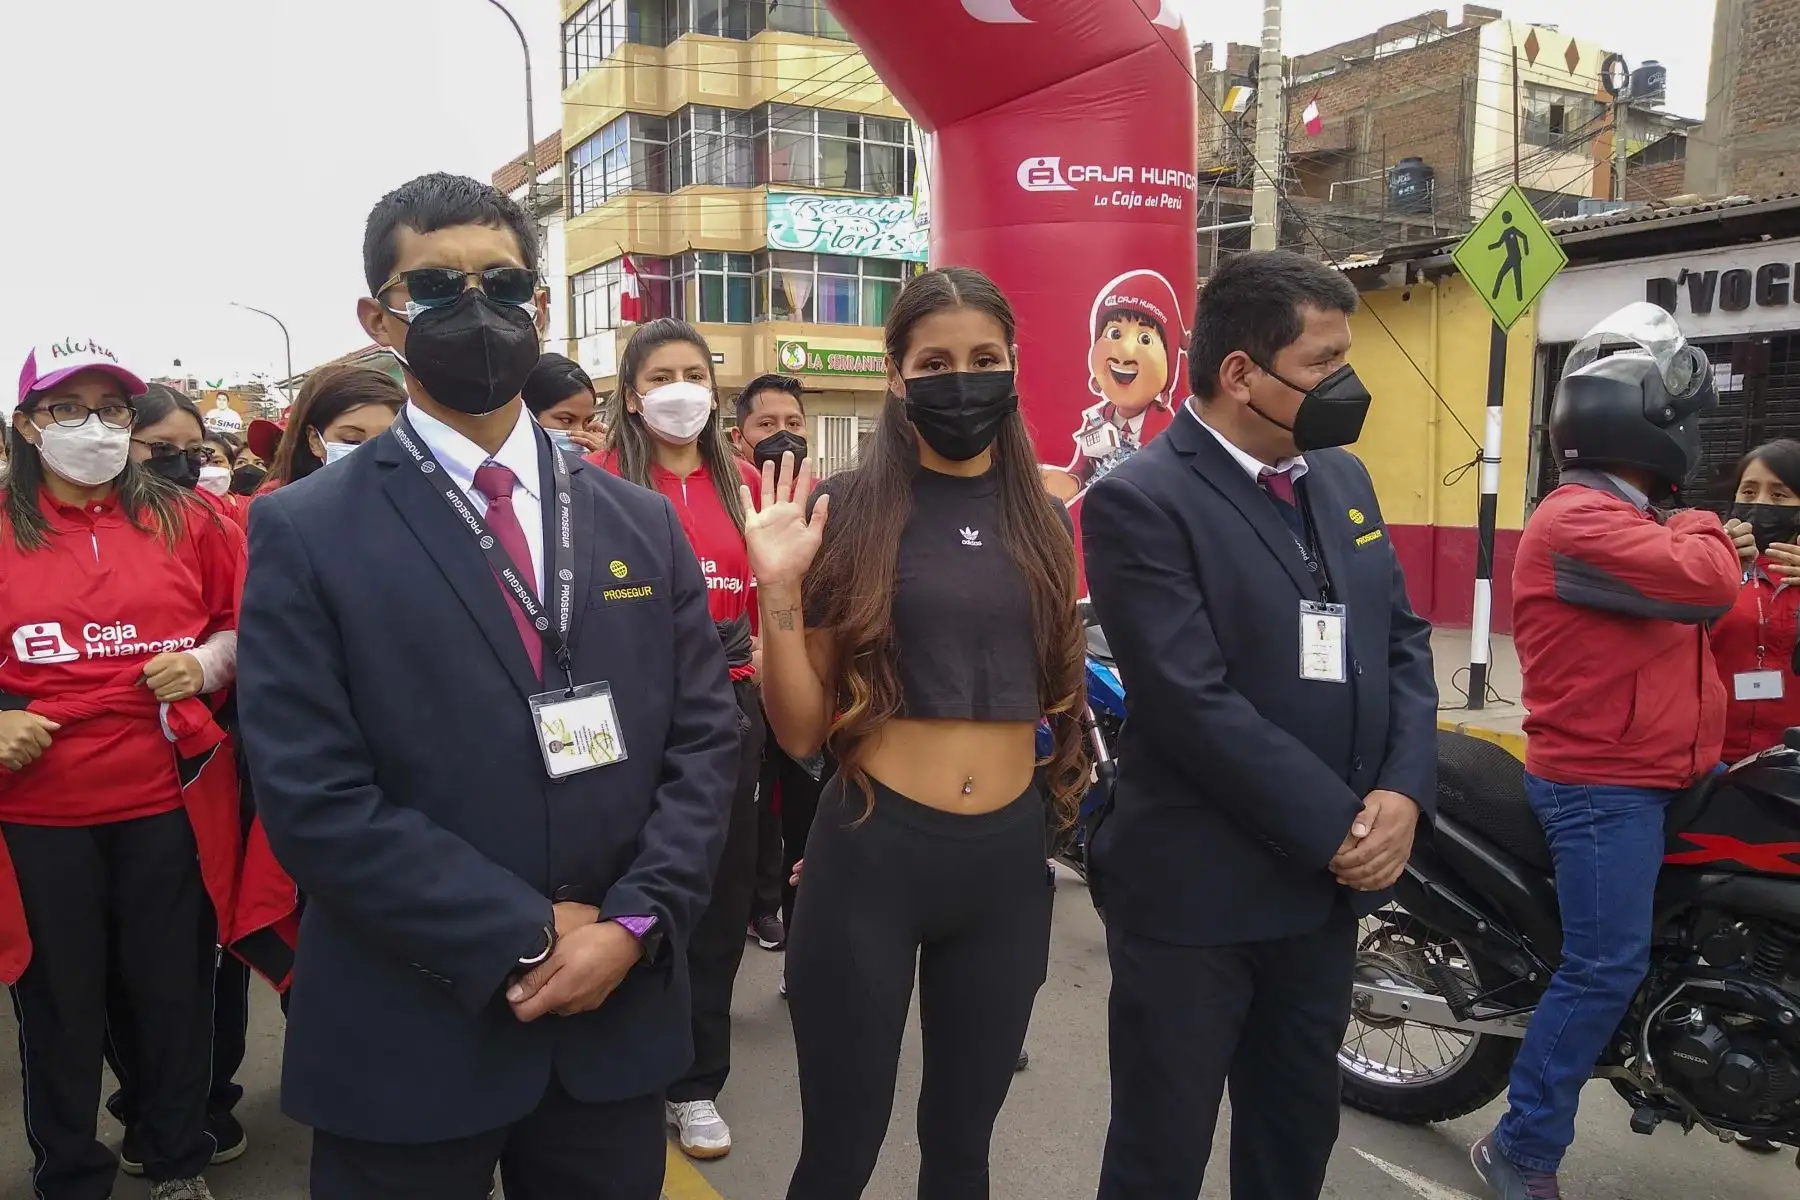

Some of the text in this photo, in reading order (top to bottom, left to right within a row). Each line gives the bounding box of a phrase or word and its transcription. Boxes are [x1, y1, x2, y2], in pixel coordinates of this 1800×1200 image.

[1067, 165, 1134, 183] CAJA
[1094, 191, 1182, 210] La Caja del Perú
[789, 198, 913, 229] Beauty
[1646, 262, 1800, 317] D'VOG
[807, 353, 823, 370] LA
[396, 426, 424, 461] PROSEGUR
[446, 489, 484, 535] PROSEGUR
[561, 505, 570, 549] PROSEGUR
[701, 556, 717, 576] ja
[502, 568, 538, 616] PROSEGUR
[603, 586, 653, 601] PROSEGUR
[560, 584, 570, 633] PROSEGUR
[82, 620, 138, 645] Caja
[85, 636, 196, 660] Huancayo
[1673, 1050, 1709, 1065] HONDA
